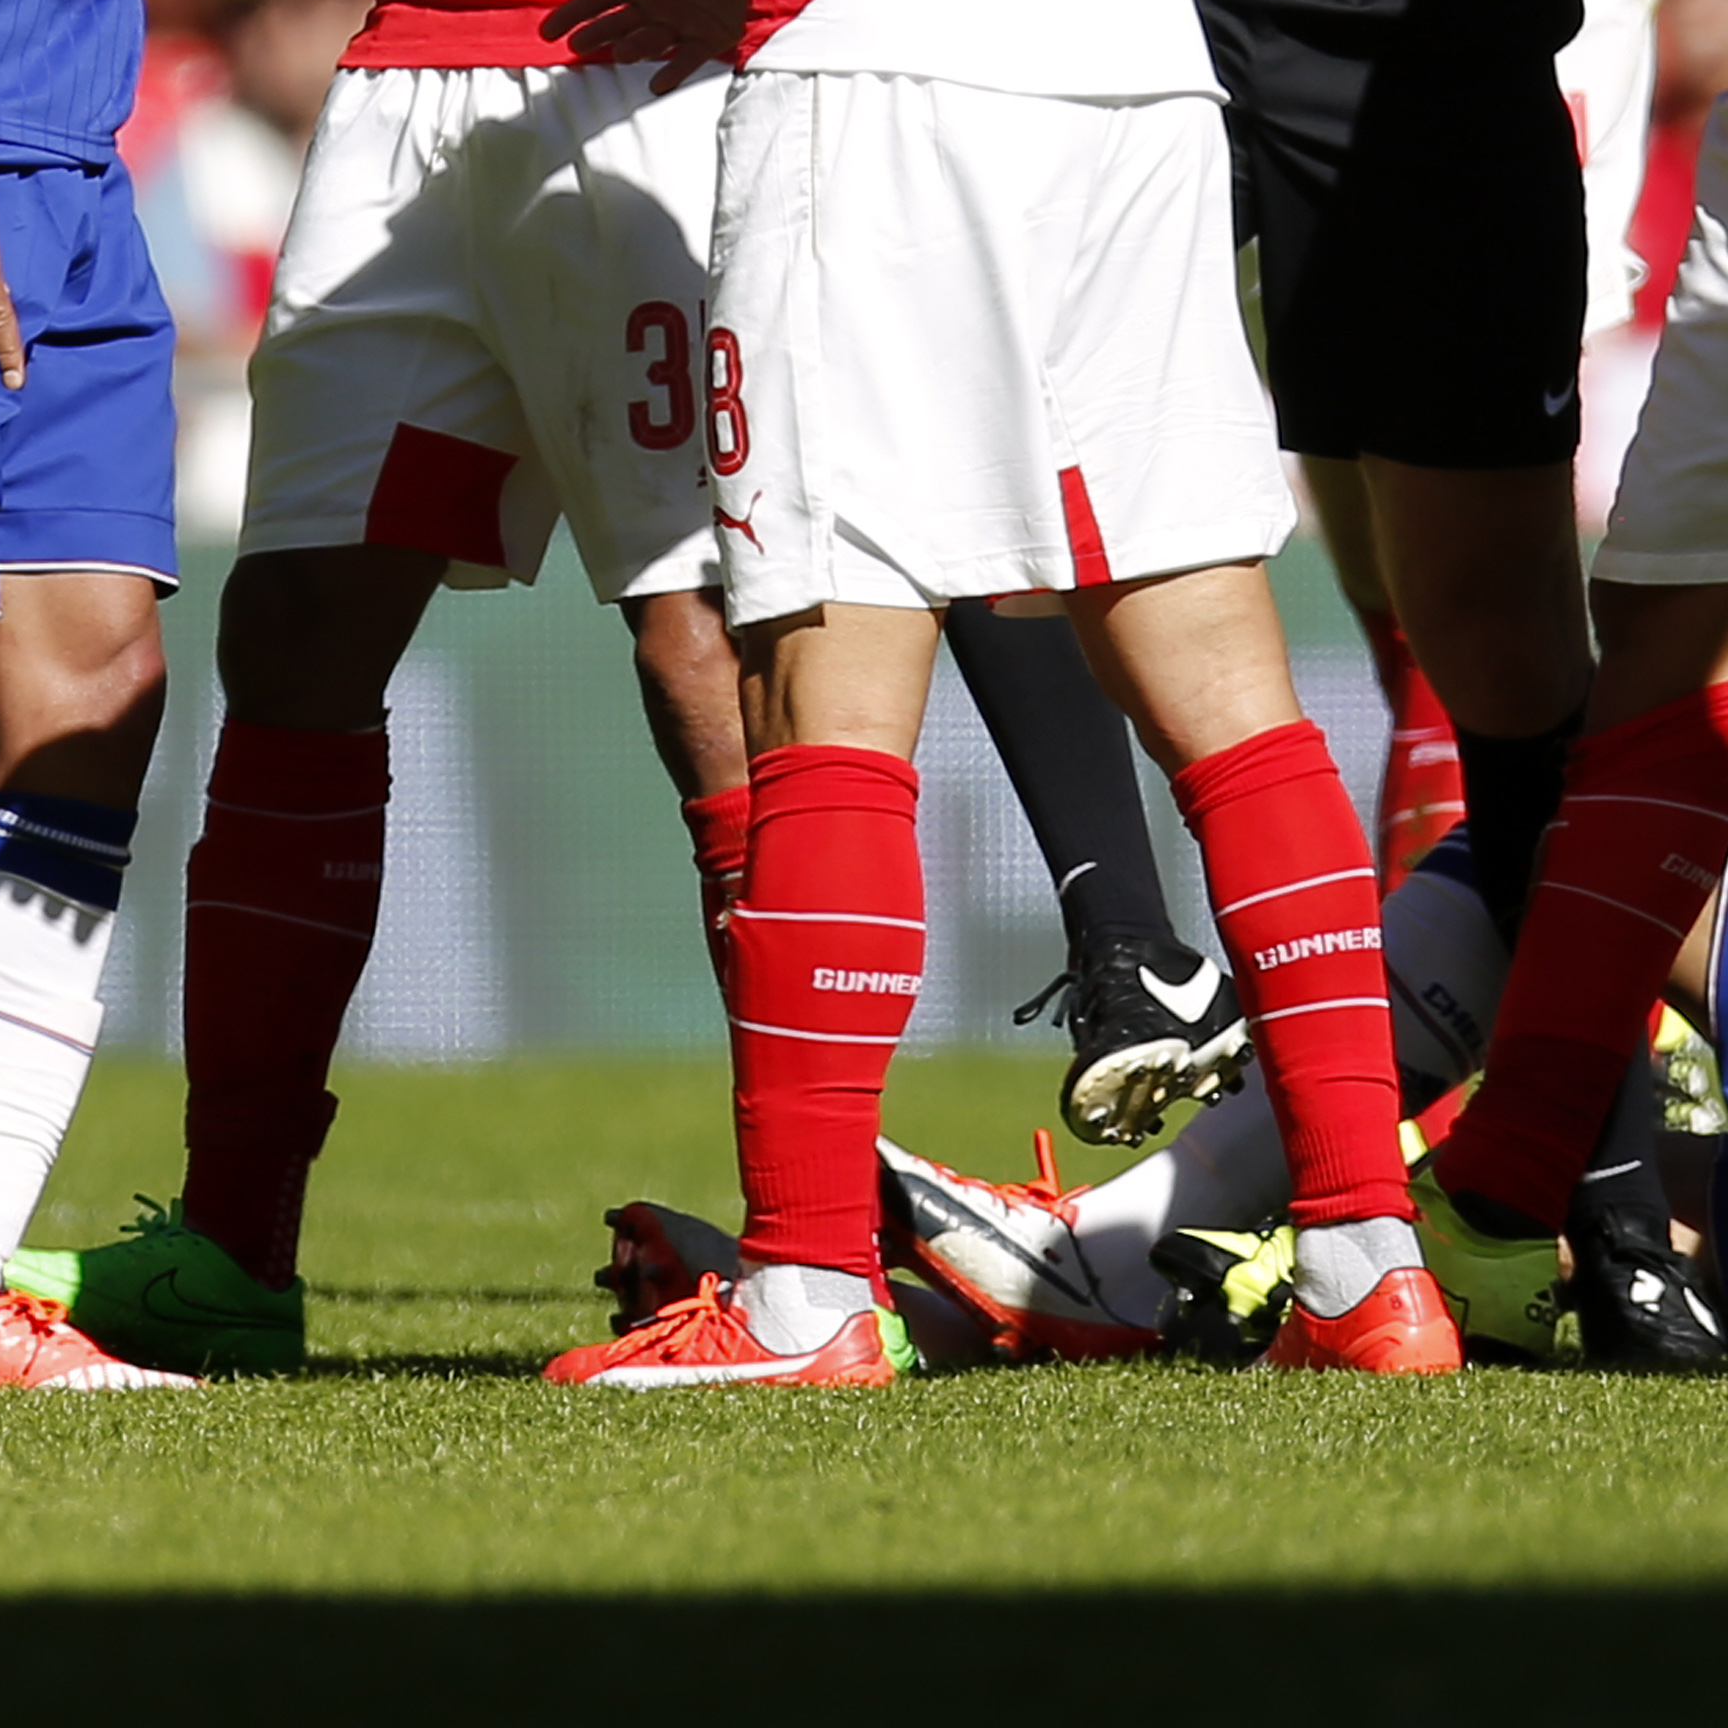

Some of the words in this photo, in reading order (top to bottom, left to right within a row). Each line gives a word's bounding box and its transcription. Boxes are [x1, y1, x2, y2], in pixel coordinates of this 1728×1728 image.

[625, 300, 707, 452] 3
[705, 327, 751, 477] 8
[812, 966, 924, 996] GUNNER
